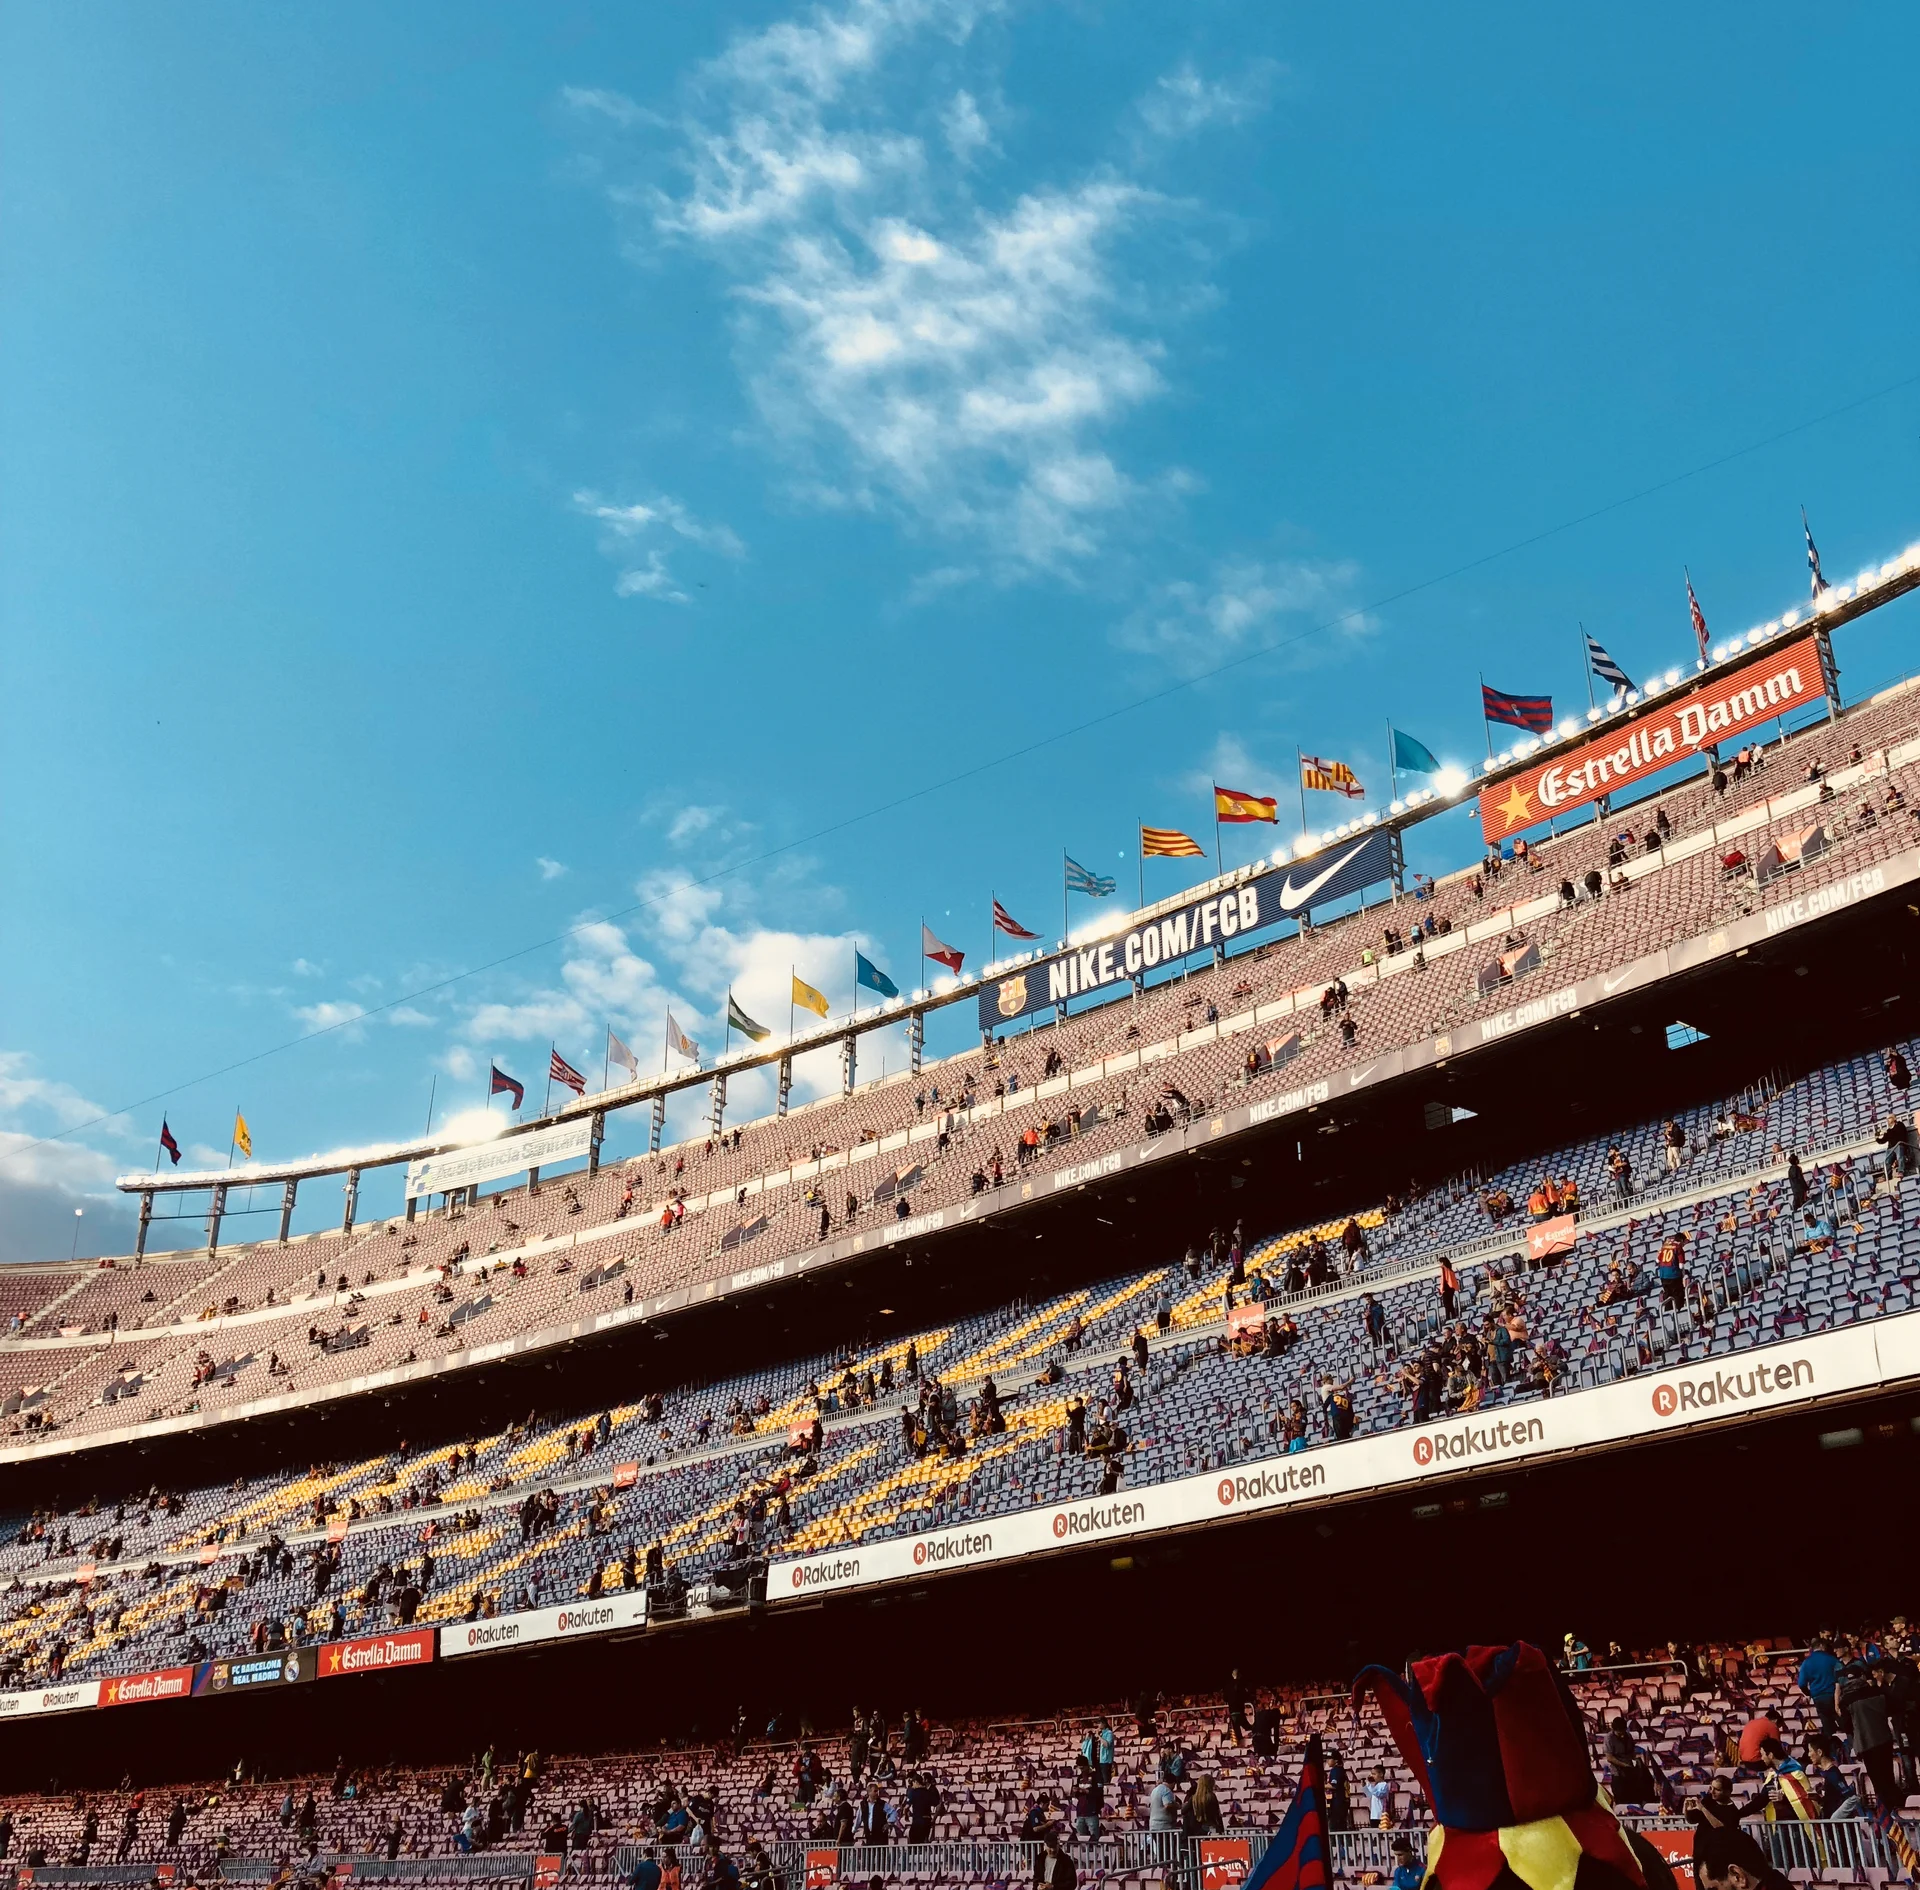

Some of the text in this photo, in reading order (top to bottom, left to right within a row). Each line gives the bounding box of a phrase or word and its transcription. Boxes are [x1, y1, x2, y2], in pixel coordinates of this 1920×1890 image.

[1537, 667, 1805, 807] Estrella Damm
[1765, 868, 1886, 933] NIKE.COM/FCB
[1048, 886, 1259, 1001] NIKE.COM/FCB
[1481, 988, 1578, 1041] NIKE.COM/FCB
[1249, 1081, 1329, 1123] NIKE.COM/FCB
[1054, 1154, 1121, 1190] NIKE.COM/FCB
[1662, 1249, 1673, 1262] 10
[1679, 1359, 1814, 1411] Rakuten
[1434, 1417, 1545, 1462] Rakuten
[1235, 1463, 1325, 1502] Rakuten
[1069, 1500, 1145, 1535] Rakuten
[927, 1532, 993, 1563] Rakuten
[803, 1559, 860, 1586] Rakuten
[476, 1624, 519, 1644] Rakuten
[567, 1607, 614, 1629] Rakuten
[231, 1659, 282, 1675] FC BARCELONA
[342, 1641, 422, 1669] Estrella Damm
[118, 1676, 183, 1701] Estrella Damm
[232, 1670, 280, 1685] REAL MADRID
[49, 1691, 80, 1706] Rakuten
